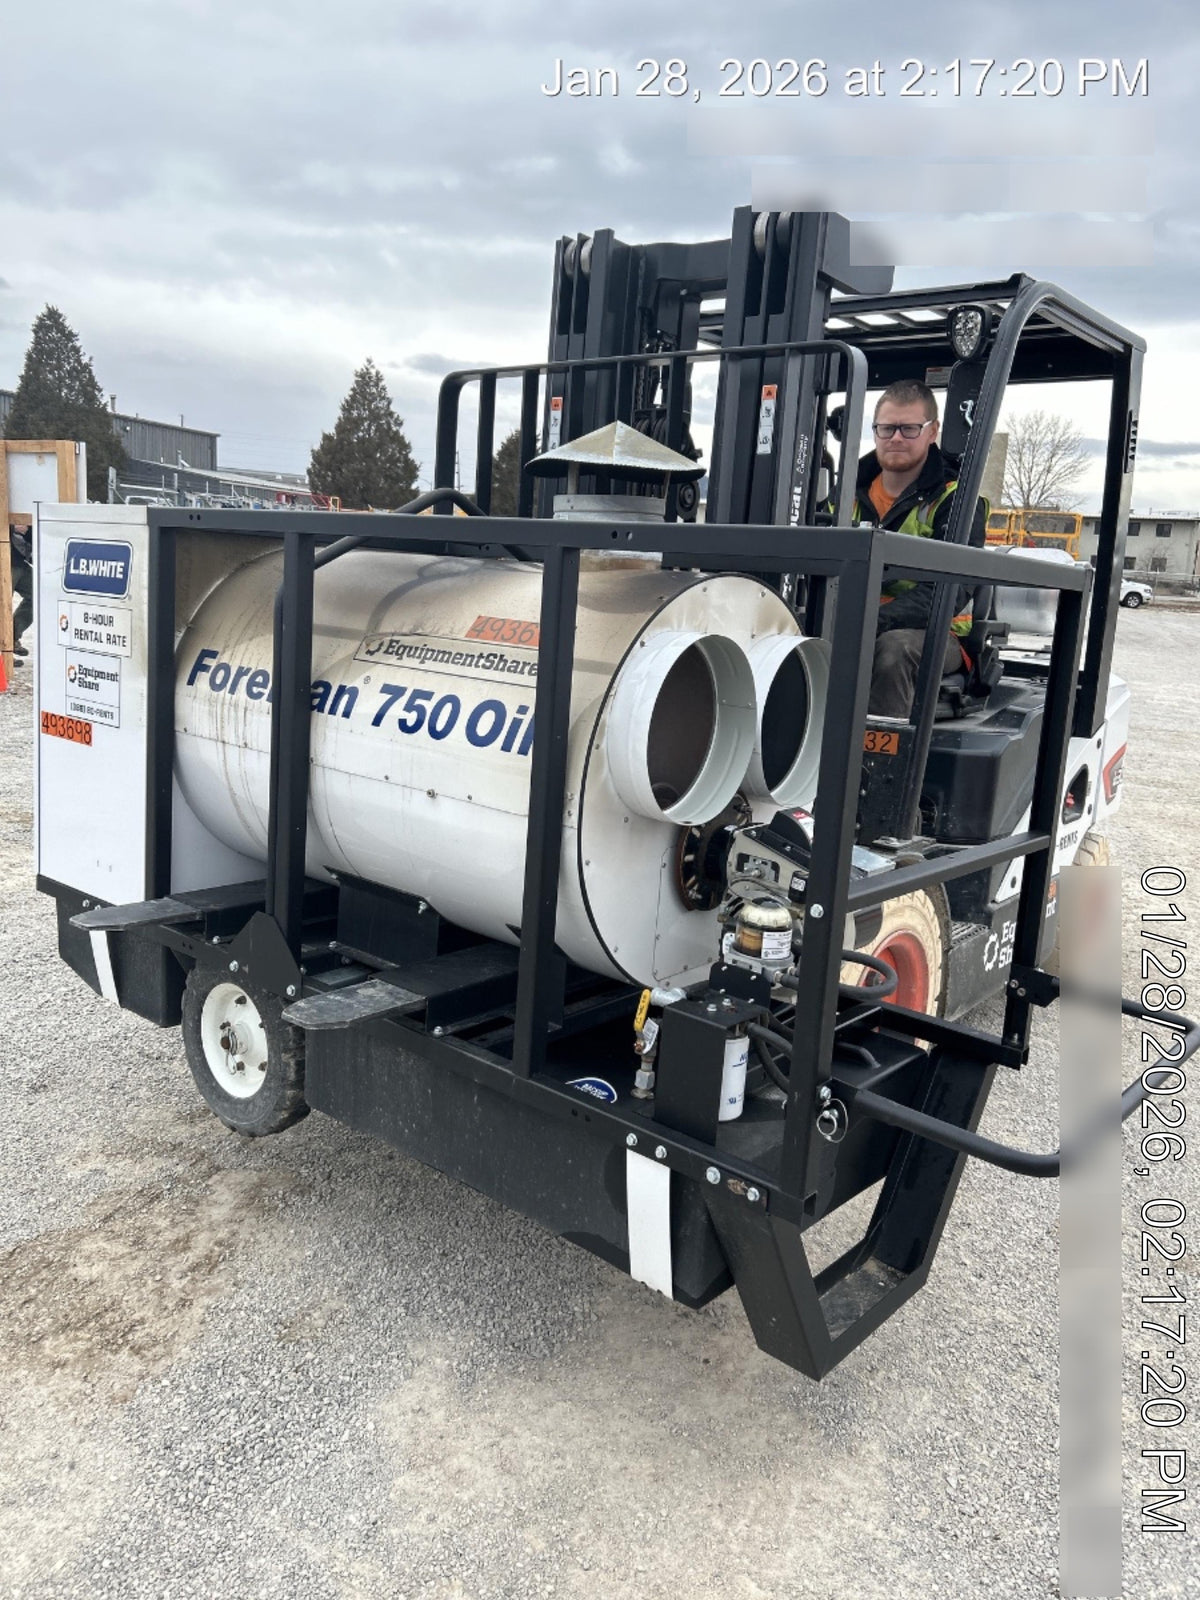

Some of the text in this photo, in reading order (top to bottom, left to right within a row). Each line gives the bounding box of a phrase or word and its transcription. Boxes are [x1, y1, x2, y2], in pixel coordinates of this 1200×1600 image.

[70, 557, 125, 579] L.B.WHITE
[83, 612, 115, 628] 8-HOUR
[471, 616, 539, 644] 4936
[74, 628, 127, 648] RENTAL RATE
[383, 639, 539, 677] EquipmentShare
[78, 664, 119, 683] Equipment
[78, 676, 100, 691] Share
[186, 648, 360, 719] Forean
[371, 683, 462, 741] 750
[41, 712, 92, 745] 493698
[865, 731, 892, 752] 32
